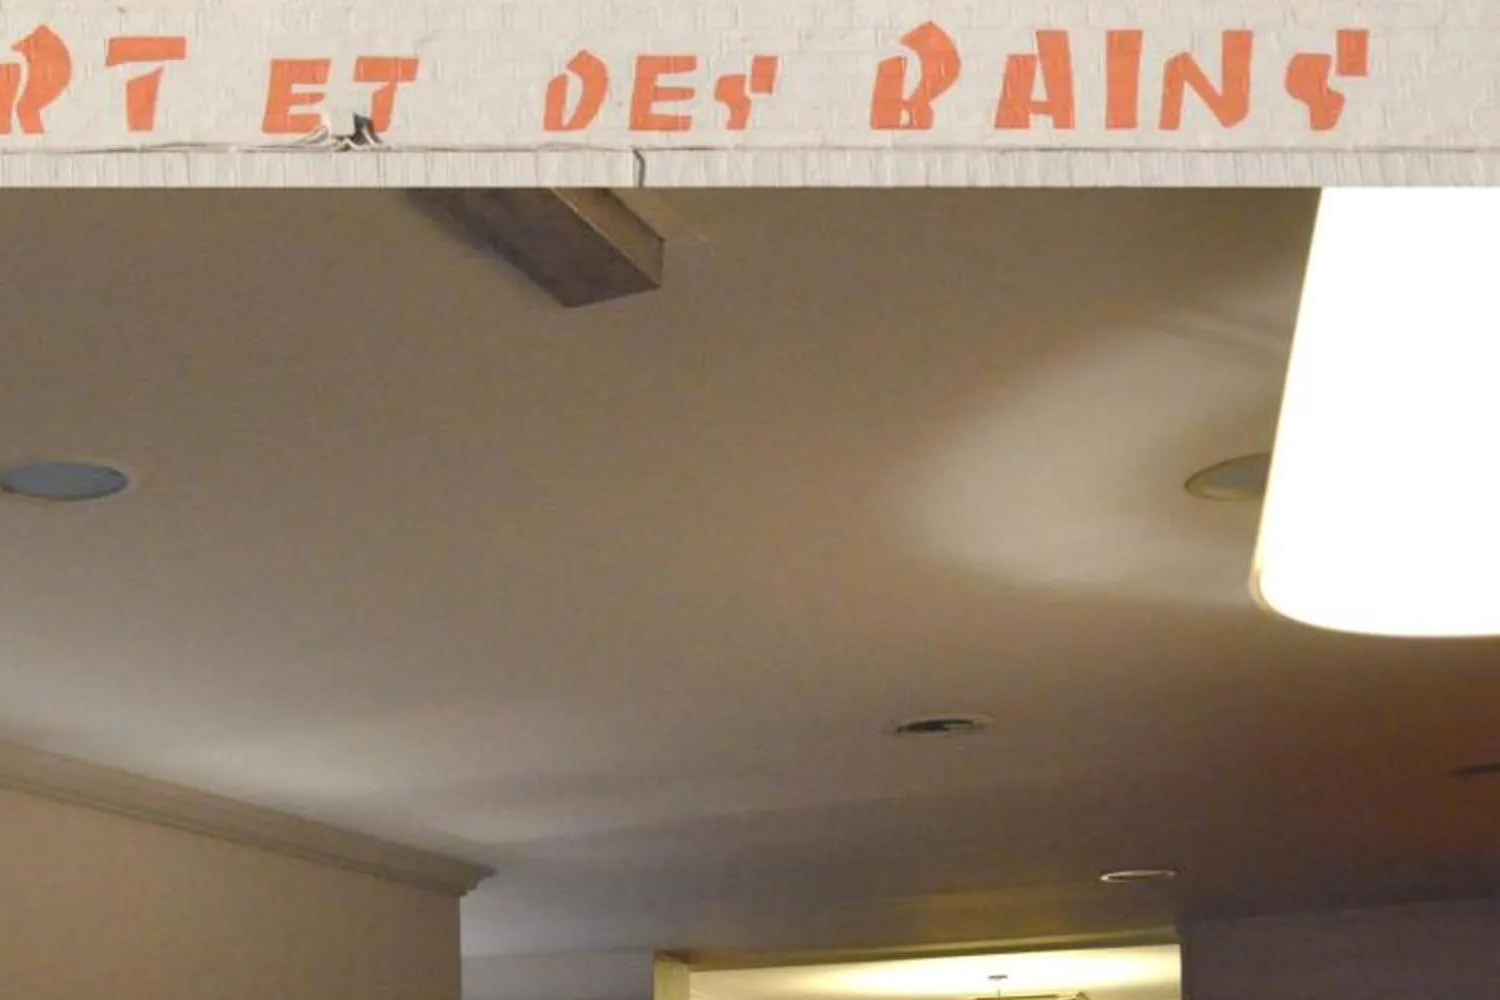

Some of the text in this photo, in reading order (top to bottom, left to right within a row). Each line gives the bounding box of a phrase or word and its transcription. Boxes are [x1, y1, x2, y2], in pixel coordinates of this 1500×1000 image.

[259, 54, 421, 137] ET
[541, 50, 779, 135] DES
[869, 20, 1371, 135] BAINS
